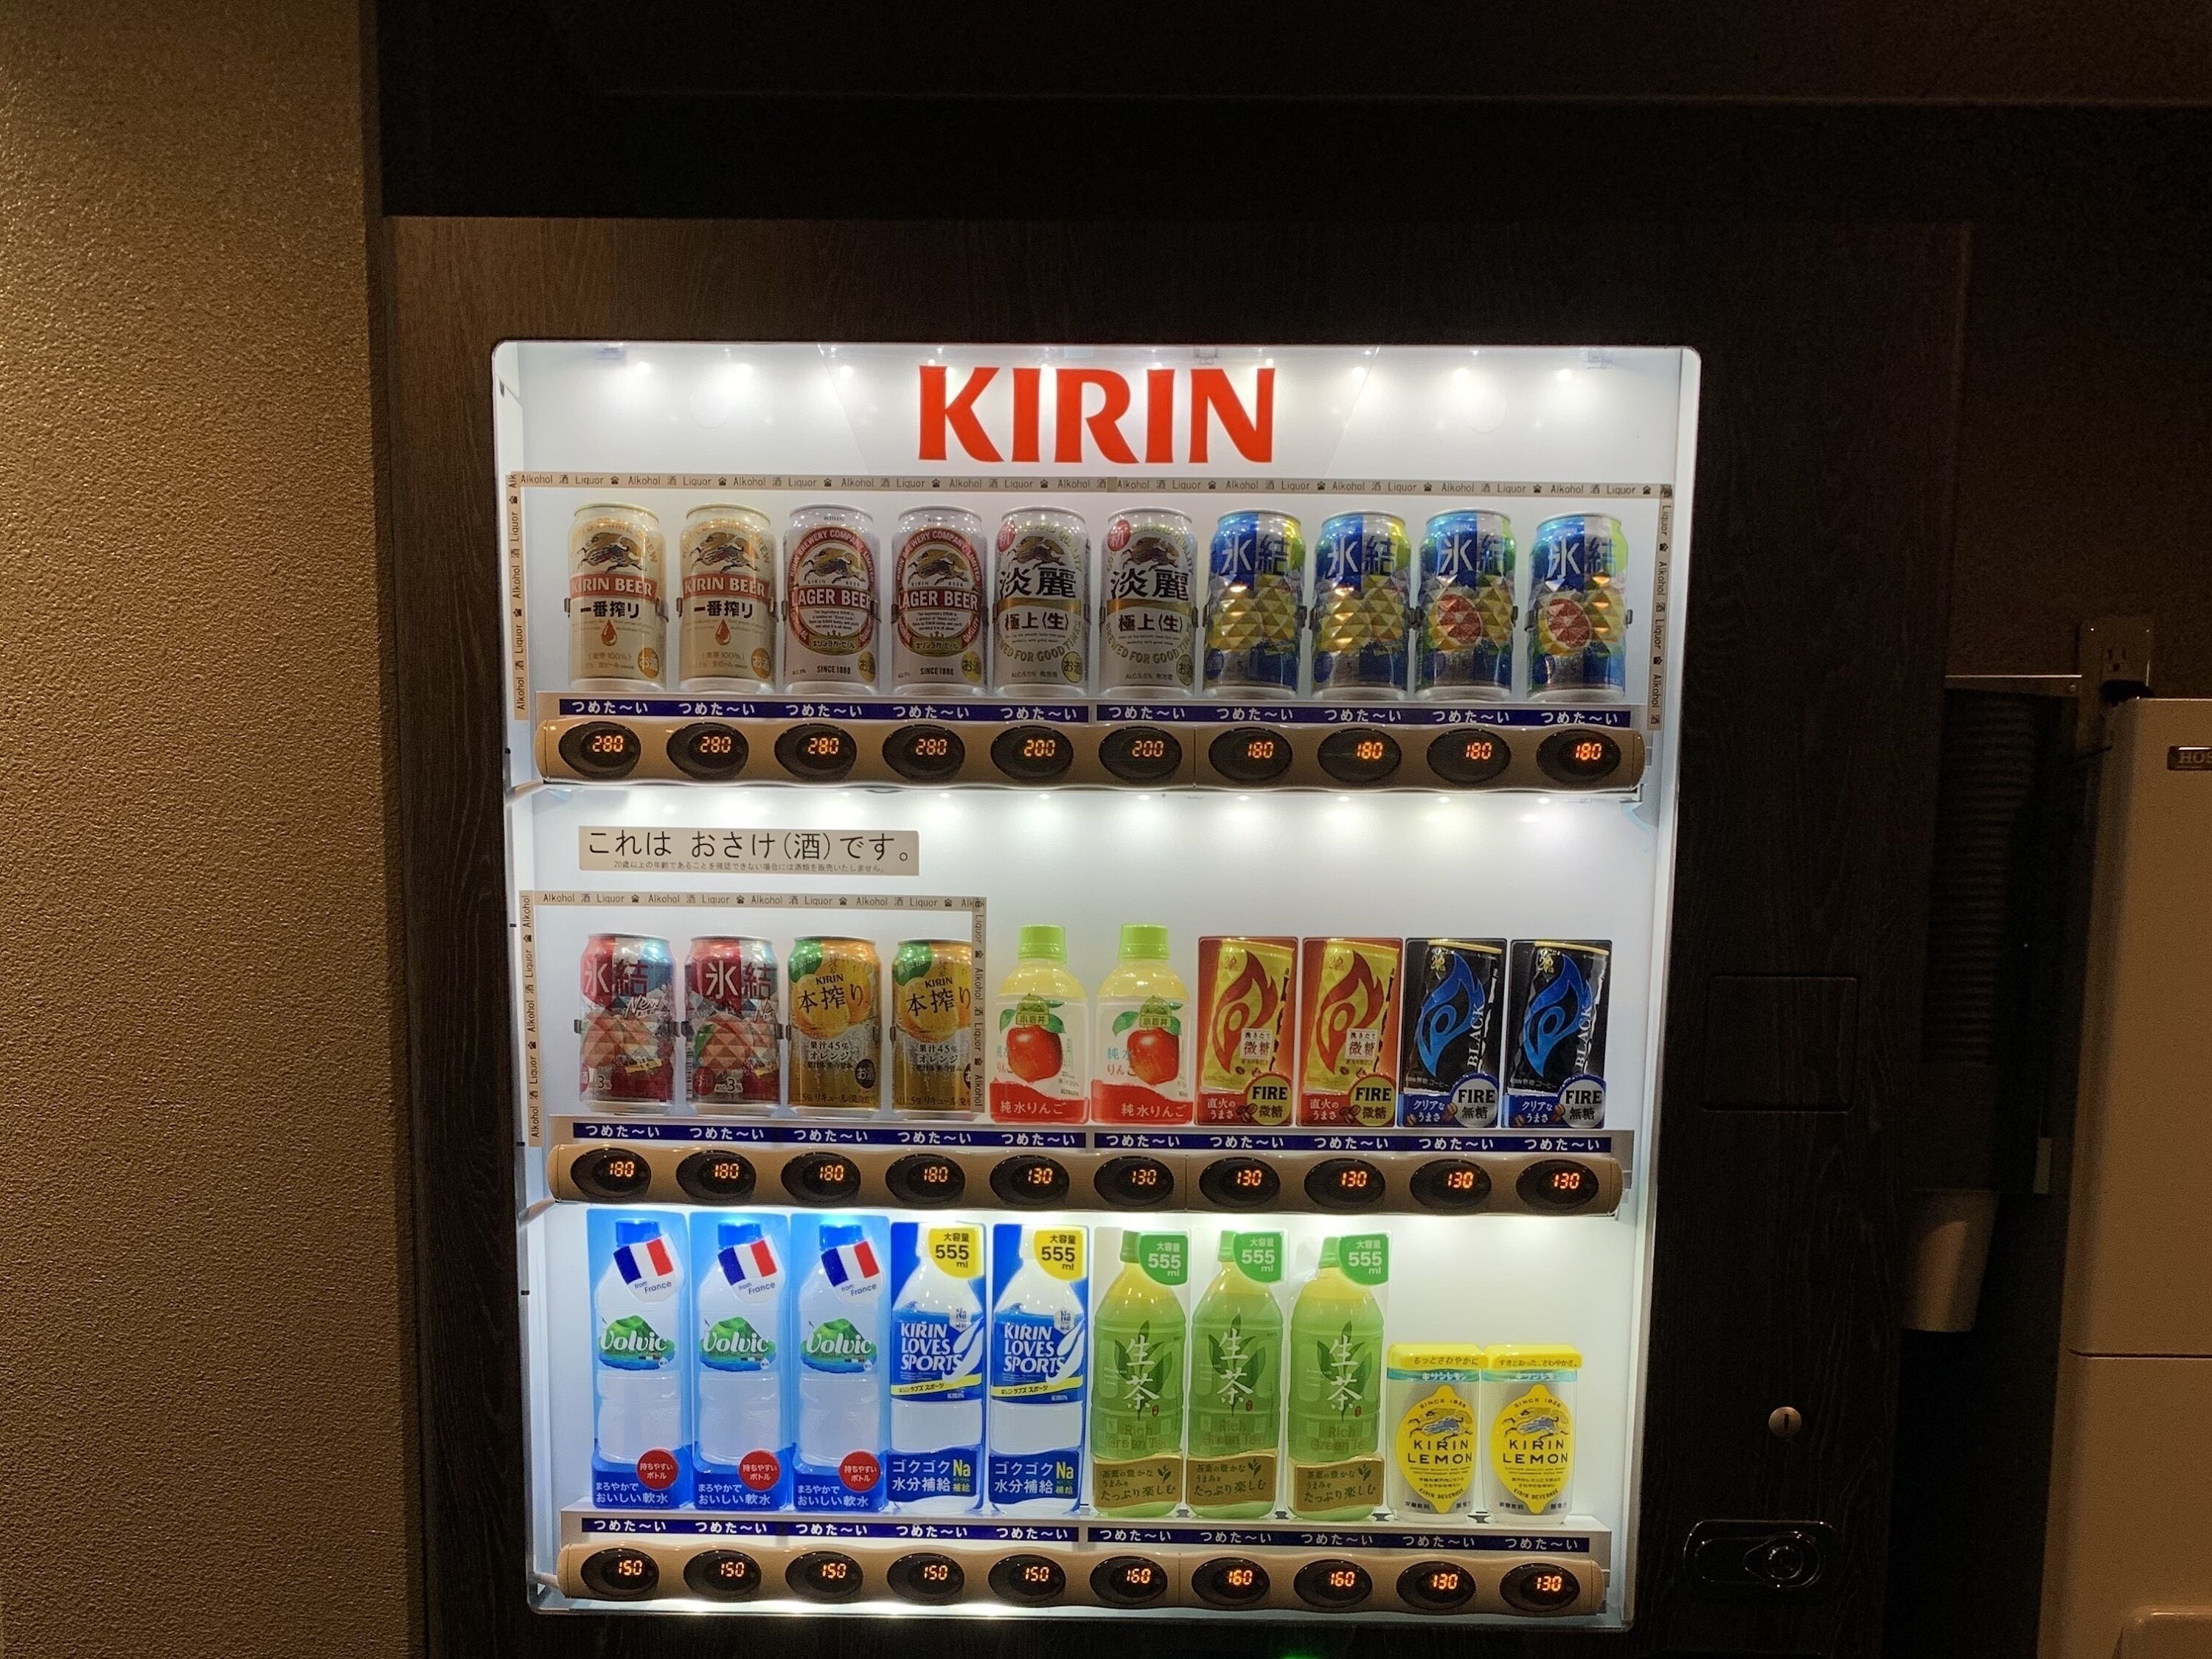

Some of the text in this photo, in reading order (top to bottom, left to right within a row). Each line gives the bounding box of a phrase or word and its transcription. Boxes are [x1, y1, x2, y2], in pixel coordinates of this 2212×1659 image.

[919, 366, 1276, 463] KIRIN
[521, 474, 552, 484] Alkohol
[576, 476, 604, 485] Liquor
[841, 478, 874, 487] Alkohol
[897, 478, 925, 489] Liquor
[1226, 481, 1258, 490] Alkohol
[1281, 481, 1310, 491] Liquor
[1551, 484, 1583, 493] Alkohol
[1607, 485, 1635, 495] Liquor
[571, 577, 653, 597] KIRIN BEER
[685, 577, 765, 597] KIRIN BEER
[1000, 567, 1077, 599] 淡麗
[1110, 568, 1189, 600] 淡麗
[791, 589, 872, 610] LAGER BEER
[898, 591, 978, 610] LAGER BEER
[1653, 561, 1667, 650] Alkohol Liquor
[581, 601, 640, 618] 一番搾り
[694, 600, 753, 618] 一番搾り
[1015, 646, 1065, 661] FOR GOOD
[515, 625, 526, 710] Alkohol Liquor
[592, 735, 624, 753] 280
[807, 737, 839, 754] 280
[1023, 740, 1055, 757] 200
[1132, 740, 1164, 757] 200
[1357, 742, 1383, 759] 180
[1575, 742, 1602, 761] 180
[590, 829, 671, 858] これは
[543, 894, 574, 902] Alkohol
[597, 894, 625, 904] Liquor
[816, 974, 844, 985] KIRIN
[925, 977, 953, 988] KIRIN
[798, 984, 863, 1014] 本搾り
[905, 987, 971, 1017] 本搾り
[1467, 1004, 1485, 1067] BLACK
[1575, 1005, 1594, 1068] BLACK
[810, 1051, 849, 1060] オレンジ
[1243, 1040, 1271, 1057] 微糖
[1348, 1041, 1376, 1057] 微糖
[919, 1054, 958, 1063] オレンジ
[974, 1074, 983, 1107] Alkohol
[1252, 1086, 1288, 1101] FIRE
[1355, 1088, 1391, 1102] FIRE
[1458, 1089, 1495, 1104] FIRE
[1565, 1090, 1602, 1104] FIRE
[1000, 1100, 1065, 1115] 純水りんご
[1121, 1102, 1186, 1117] 純水りんご
[1207, 1098, 1236, 1108] 直火の
[1413, 1101, 1444, 1111] クリアな
[1210, 1110, 1234, 1120] うまさ
[1259, 1105, 1284, 1118] 微糖
[1418, 1112, 1441, 1122] うまさ
[1461, 1107, 1489, 1119] 無糖
[1569, 1107, 1595, 1120] 無糖
[610, 1161, 635, 1178] 180
[819, 1165, 844, 1181] 180
[1028, 1168, 1053, 1184] 130
[1237, 1169, 1262, 1186] 130
[1447, 1172, 1474, 1189] 130
[1554, 1172, 1580, 1189] 130
[944, 1233, 969, 1242] 大容量
[1050, 1235, 1076, 1244] 大容量
[936, 1244, 969, 1260] 555
[1041, 1246, 1075, 1262] 555
[1156, 1242, 1180, 1252] 大容量
[1148, 1254, 1180, 1268] 555
[1242, 1250, 1275, 1265] 555
[1348, 1252, 1382, 1266] 555
[1167, 1267, 1180, 1277] ml
[634, 1280, 672, 1294] from France
[738, 1282, 776, 1295] from France
[850, 1283, 877, 1296] France
[900, 1323, 947, 1338] KIRIN
[1004, 1324, 1051, 1340] KIRIN
[600, 1329, 667, 1352] Volvic
[703, 1330, 768, 1353] Volvic
[806, 1332, 872, 1354] Volvic
[901, 1338, 950, 1354] LOVES
[1004, 1340, 1054, 1357] LOVES
[900, 1354, 962, 1373] SPORTS
[1003, 1356, 1066, 1374] SPORTS
[1414, 1357, 1478, 1366] もっとさわやかに
[1124, 1335, 1159, 1411] 生茶
[1327, 1335, 1362, 1411] 生茶
[1413, 1439, 1469, 1450] KIRIN
[1509, 1439, 1565, 1450] KIRIN
[1408, 1453, 1472, 1464] LEMON
[1503, 1453, 1568, 1464] LEMON
[640, 1463, 673, 1472] 持ちやすい
[742, 1464, 777, 1473] 持ちやすい
[893, 1460, 950, 1474] ゴクゴク
[953, 1459, 971, 1477] Na
[995, 1461, 1054, 1476] ゴクゴク
[647, 1472, 667, 1480] ボトル
[750, 1473, 771, 1481] ボトル
[595, 1482, 639, 1492] まろやかで
[698, 1483, 742, 1493] まろやかで
[892, 1478, 951, 1492] 水分補給
[995, 1479, 1054, 1494] 水分補給
[1101, 1484, 1176, 1500] たっぷり楽しむ
[1194, 1480, 1267, 1498] たっぷり楽しむ
[596, 1492, 669, 1505] おいしい軟水
[698, 1494, 771, 1506] おいしい軟水
[798, 1495, 869, 1507] おいしい軟水
[618, 1559, 643, 1576] 150
[822, 1562, 846, 1579] 150
[1025, 1566, 1049, 1582] 150
[1126, 1568, 1151, 1584] 160
[1330, 1571, 1355, 1587] 160
[1537, 1576, 1562, 1592] 130
